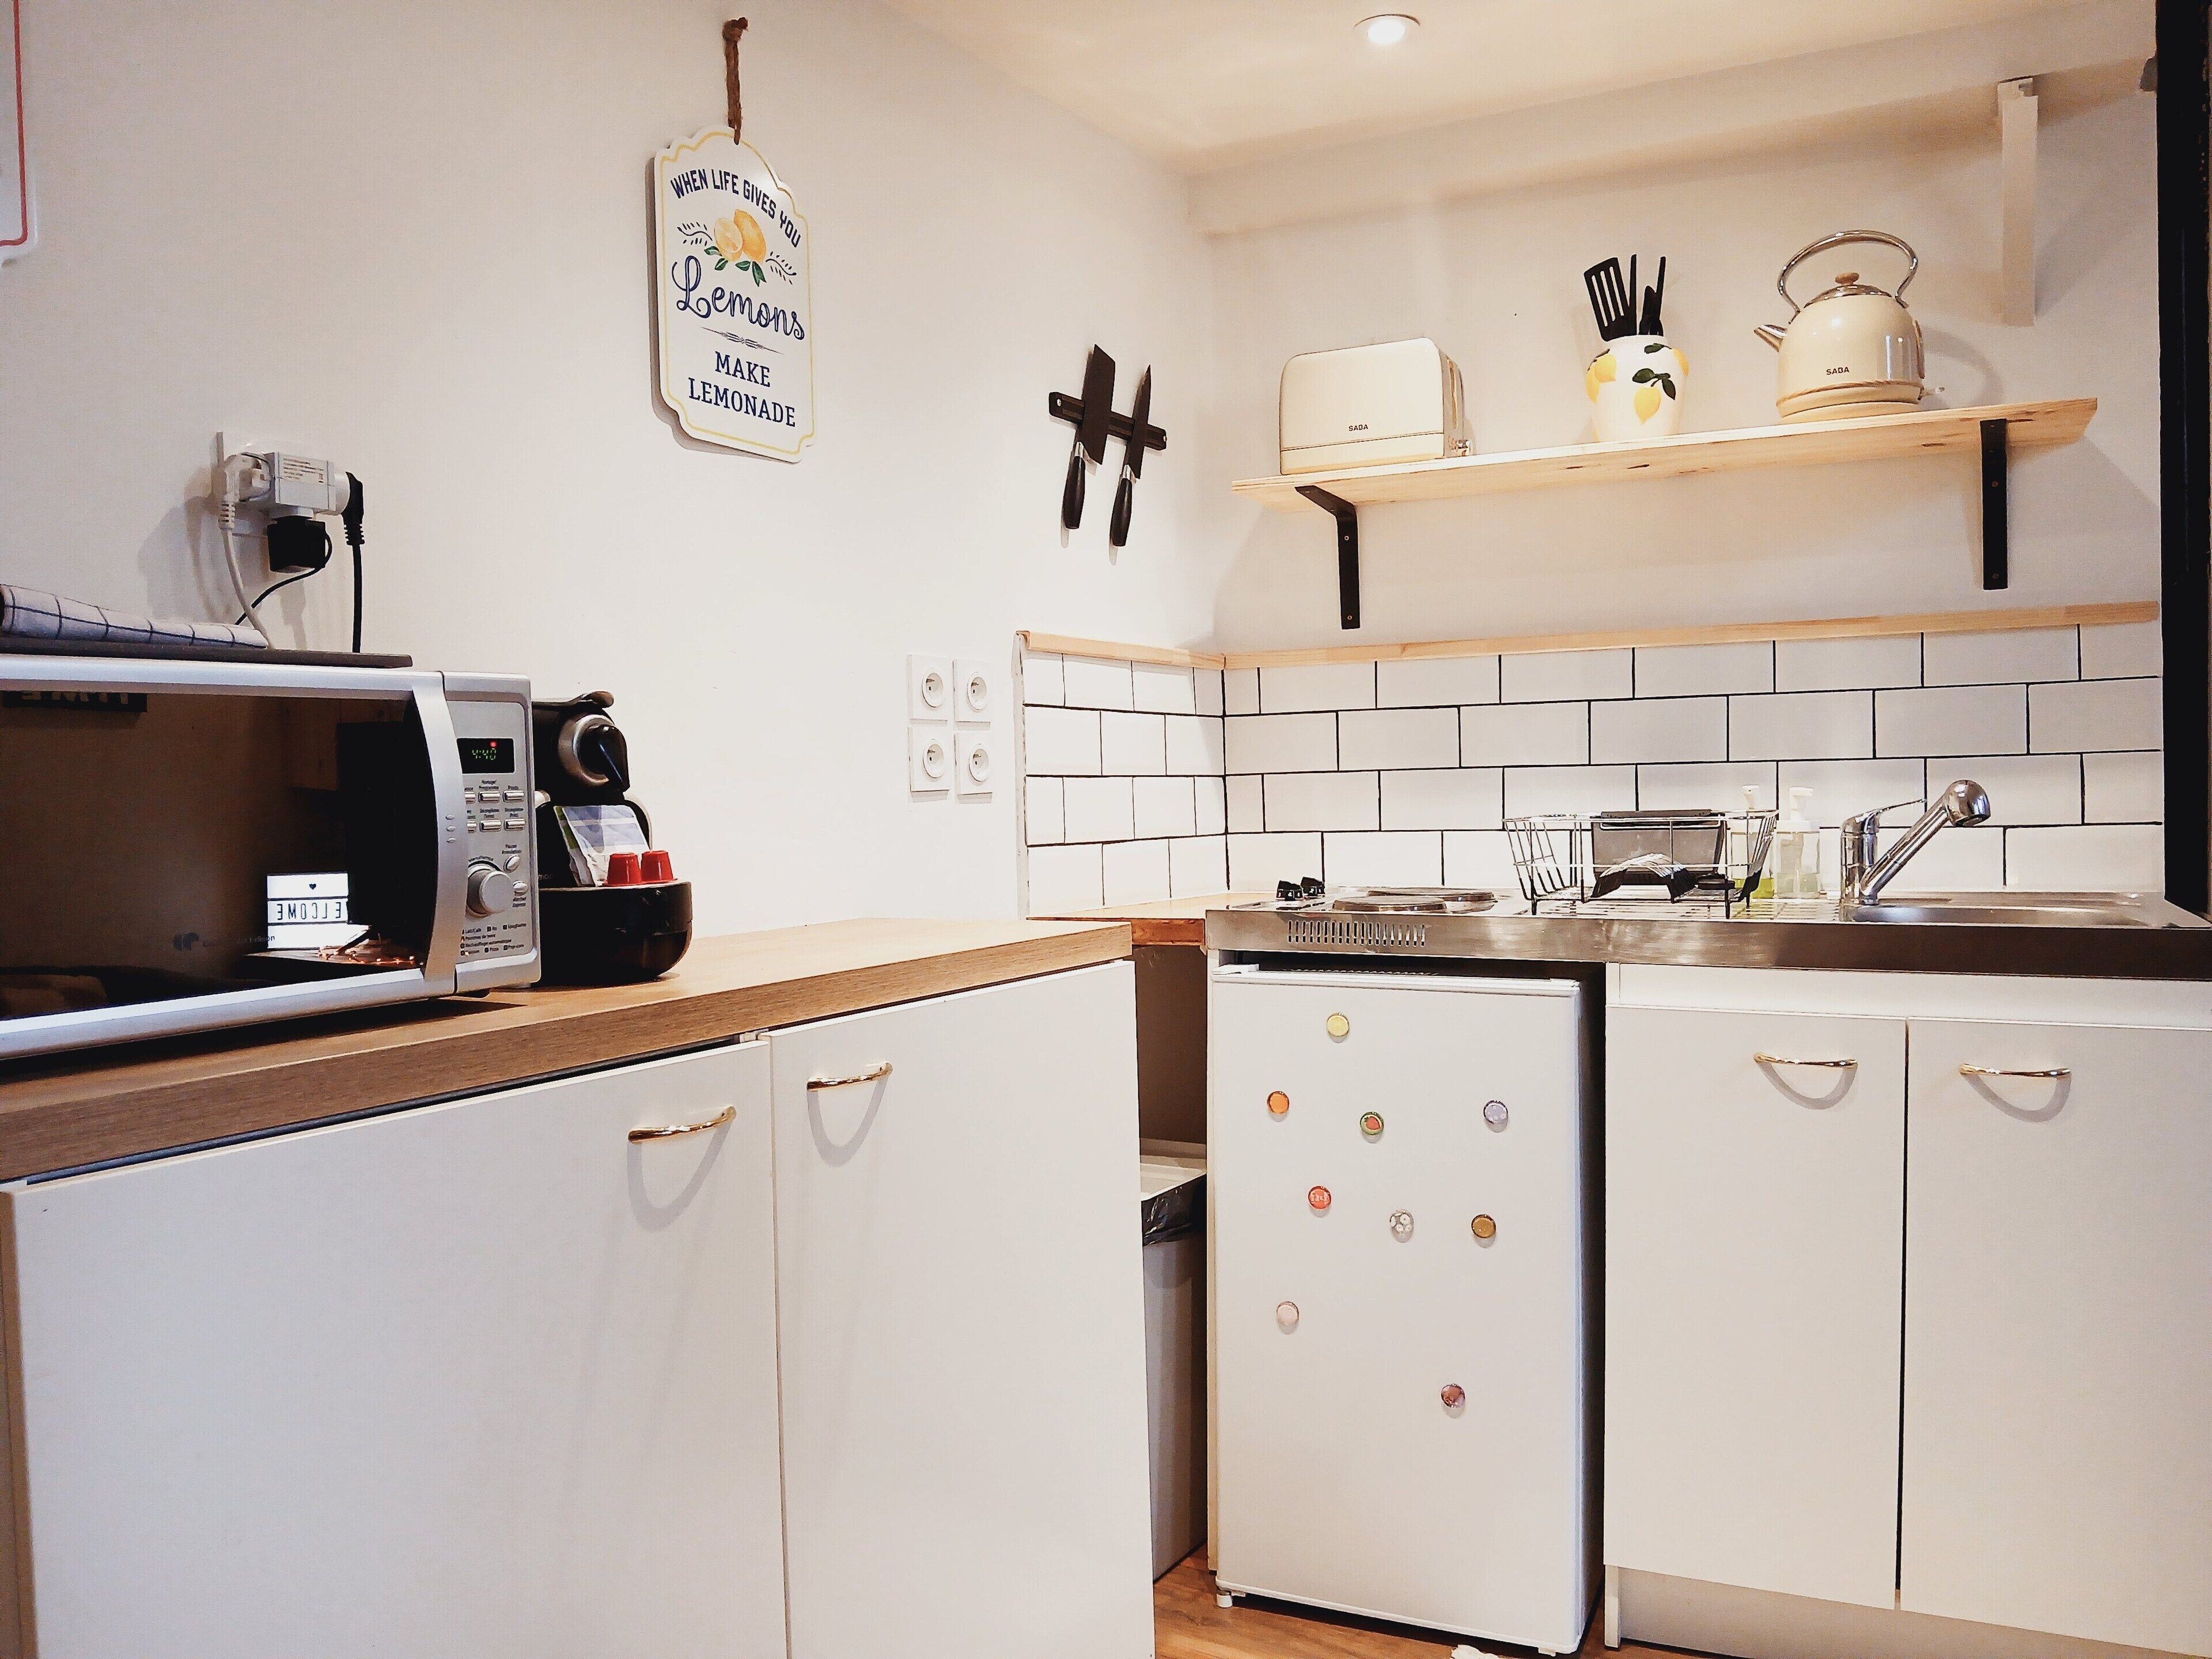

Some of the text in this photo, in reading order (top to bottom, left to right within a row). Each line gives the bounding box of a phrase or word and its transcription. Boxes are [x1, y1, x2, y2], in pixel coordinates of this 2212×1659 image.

[670, 169, 801, 248] WHEN LIFE GIVES YOU
[672, 255, 805, 340] Lemons
[715, 350, 771, 388] MAKE
[688, 377, 796, 427] LEMONADE
[472, 748, 497, 760] 4:40
